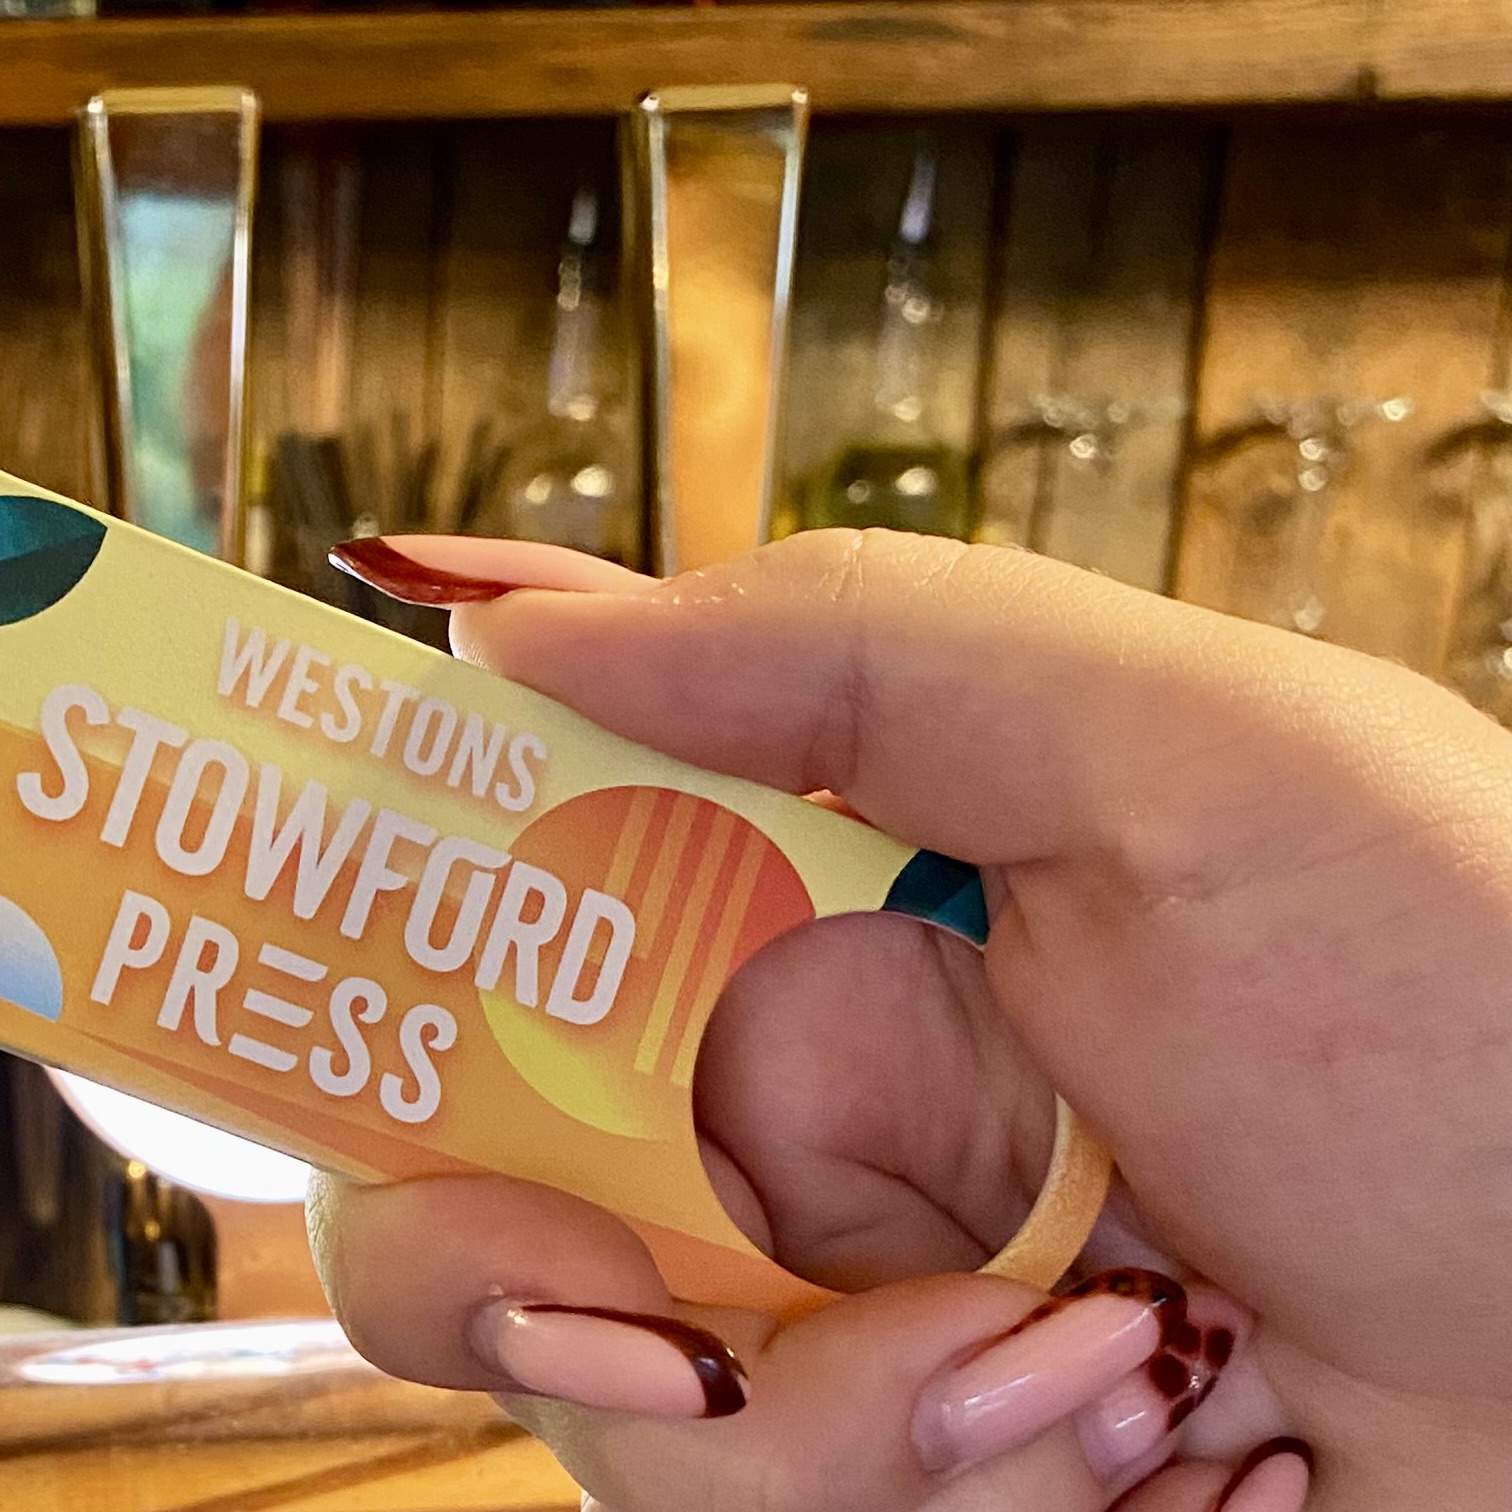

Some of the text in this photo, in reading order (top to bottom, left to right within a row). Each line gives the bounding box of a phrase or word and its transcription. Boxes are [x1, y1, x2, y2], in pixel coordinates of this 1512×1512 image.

[217, 616, 548, 813] WESTONS
[16, 683, 637, 1026] STOWFORD
[89, 889, 458, 1124] PRESS
